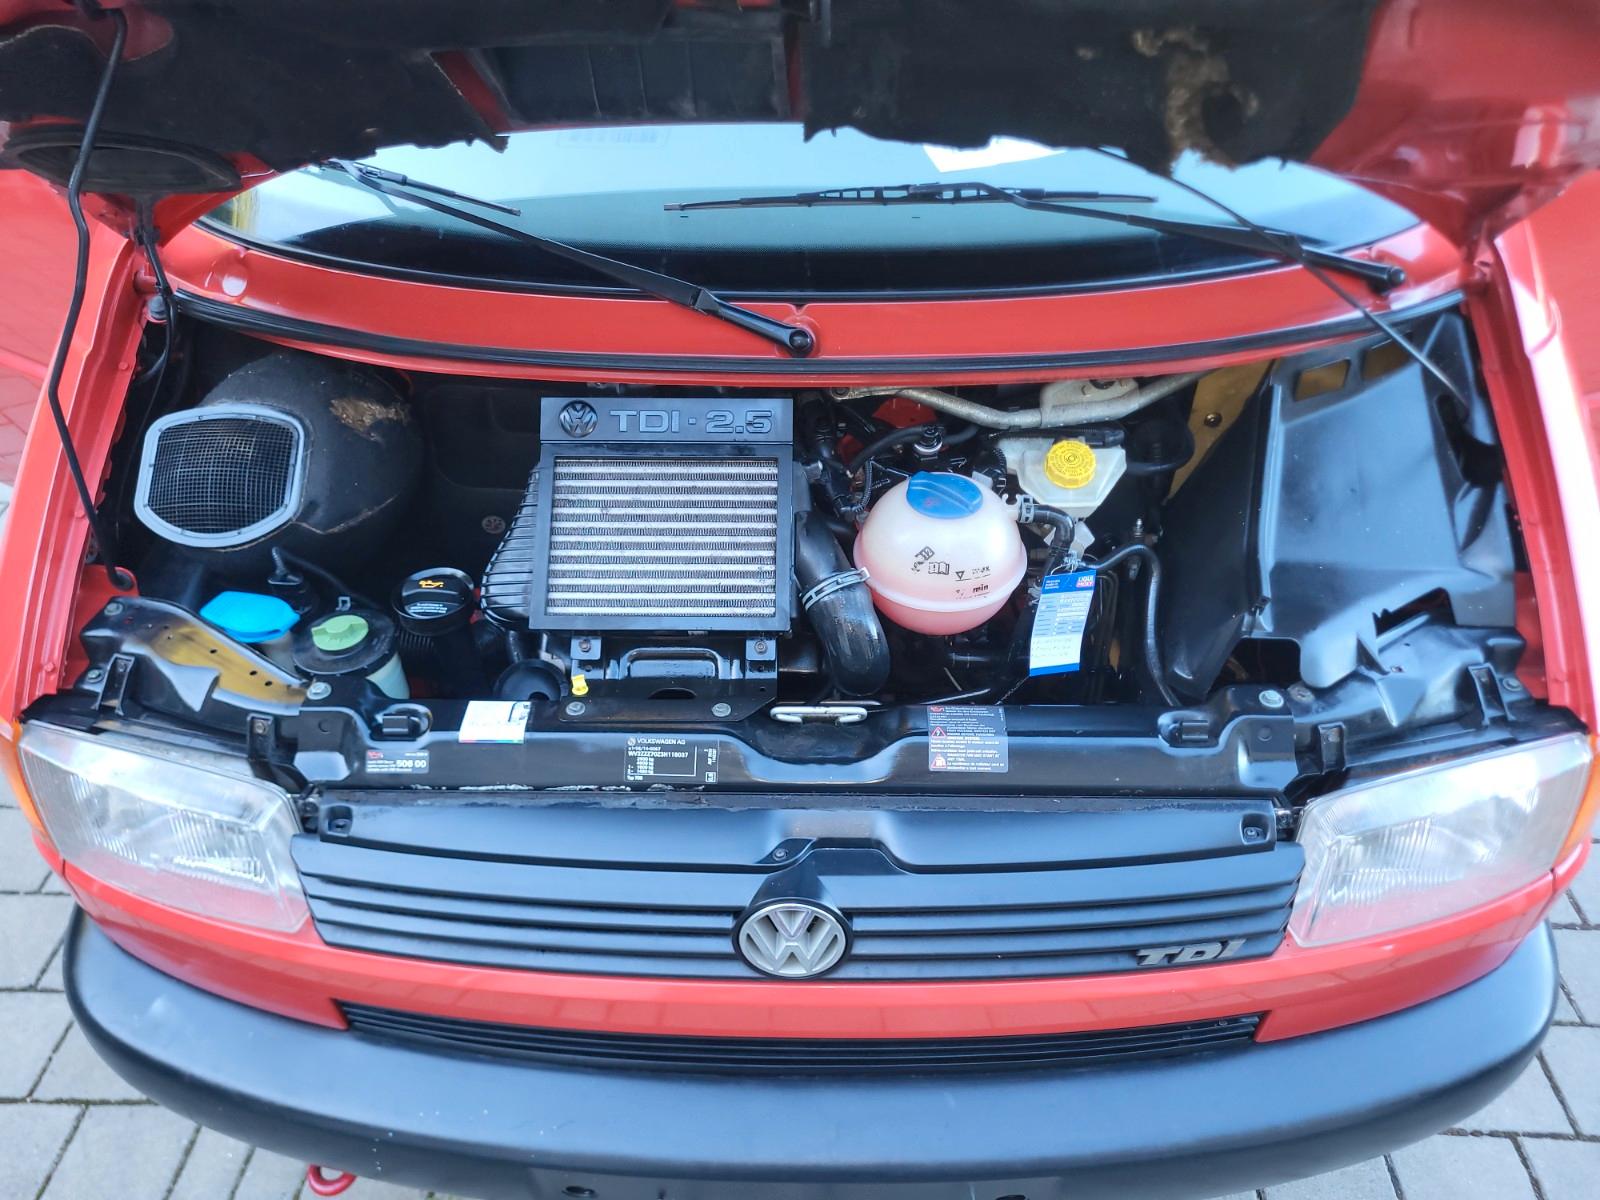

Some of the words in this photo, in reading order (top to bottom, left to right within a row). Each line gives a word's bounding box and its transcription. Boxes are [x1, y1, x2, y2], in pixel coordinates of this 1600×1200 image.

[610, 410, 680, 433] TDI
[706, 410, 773, 434] 2.5
[972, 584, 989, 593] min
[414, 760, 427, 768] 00
[739, 903, 846, 978] VW
[1136, 938, 1247, 966] TDI
